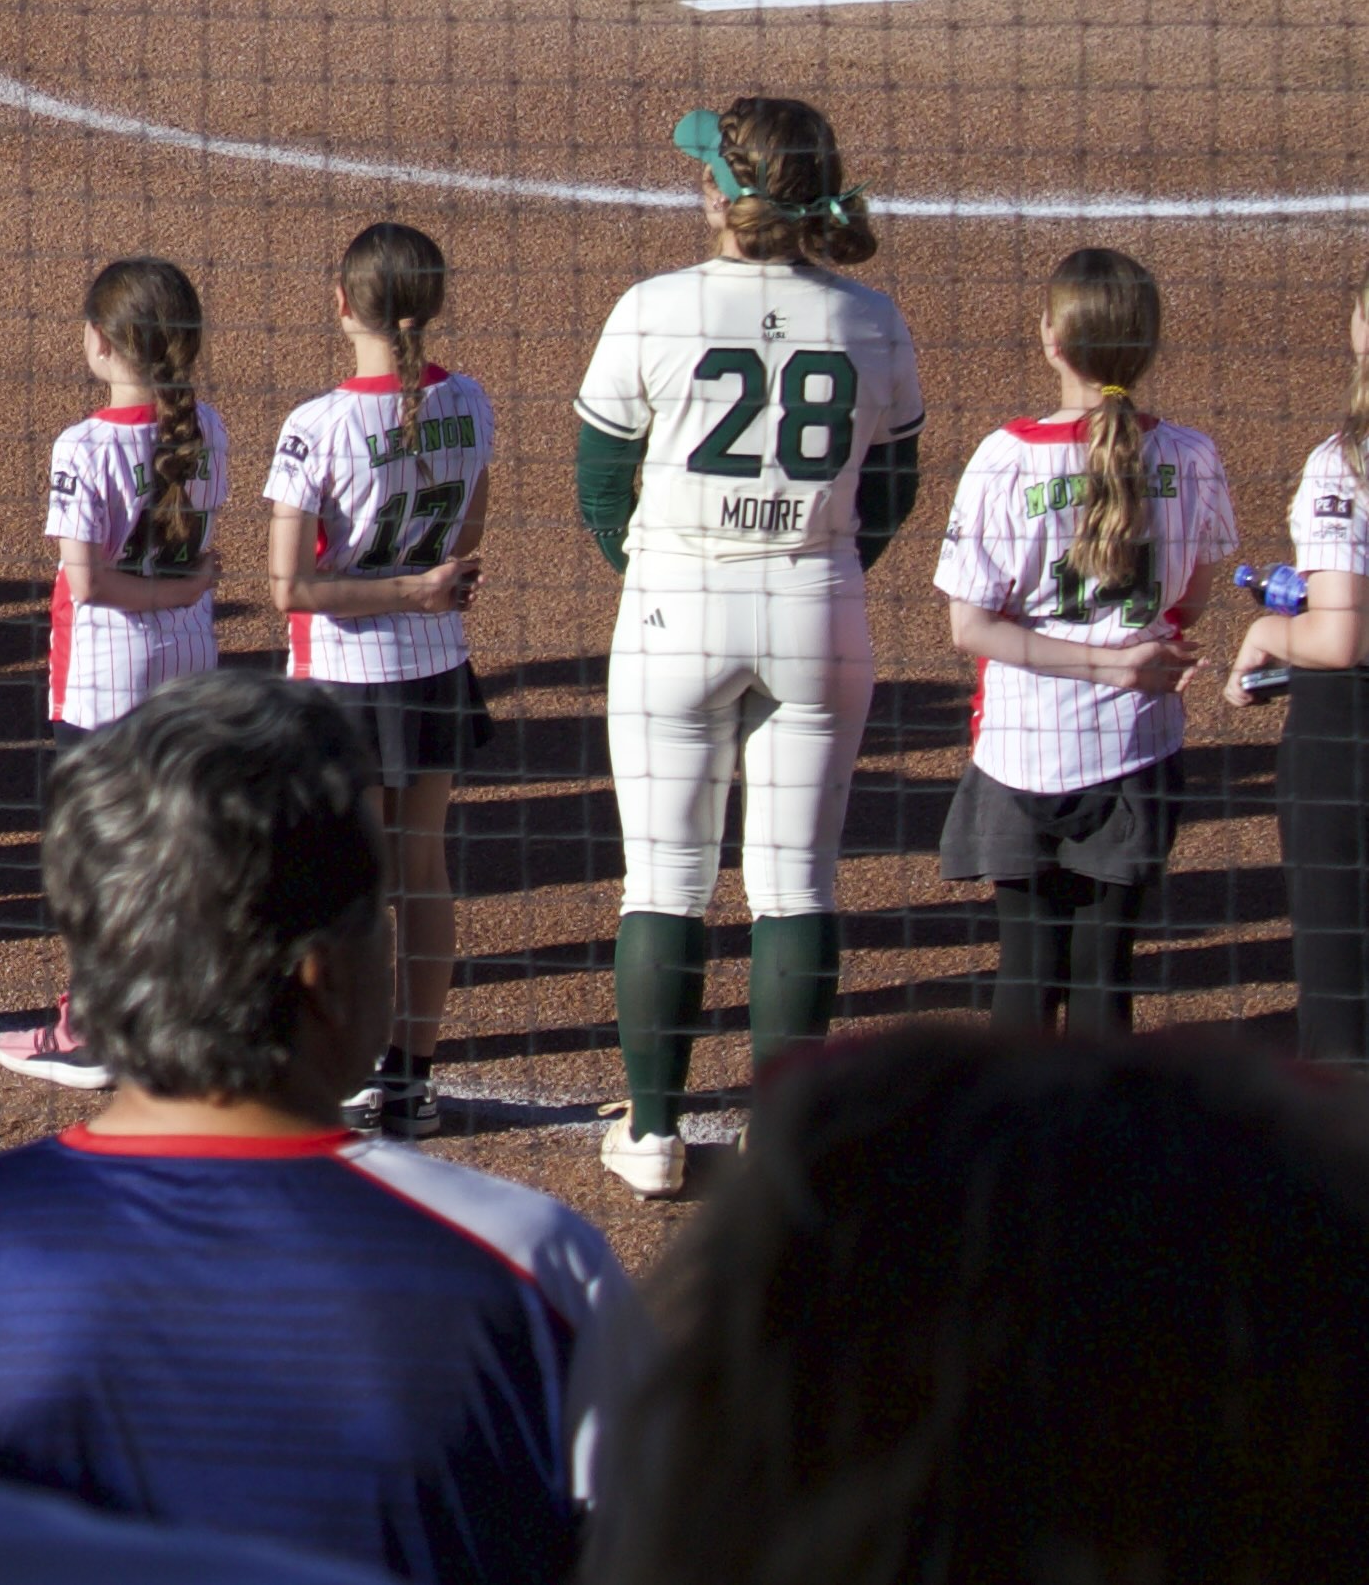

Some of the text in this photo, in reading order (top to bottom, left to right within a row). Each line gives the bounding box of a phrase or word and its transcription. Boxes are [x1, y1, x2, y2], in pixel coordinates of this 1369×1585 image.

[366, 415, 476, 468] LENON
[686, 347, 858, 482] 28
[357, 479, 465, 570] 17
[720, 495, 805, 532] MOORE
